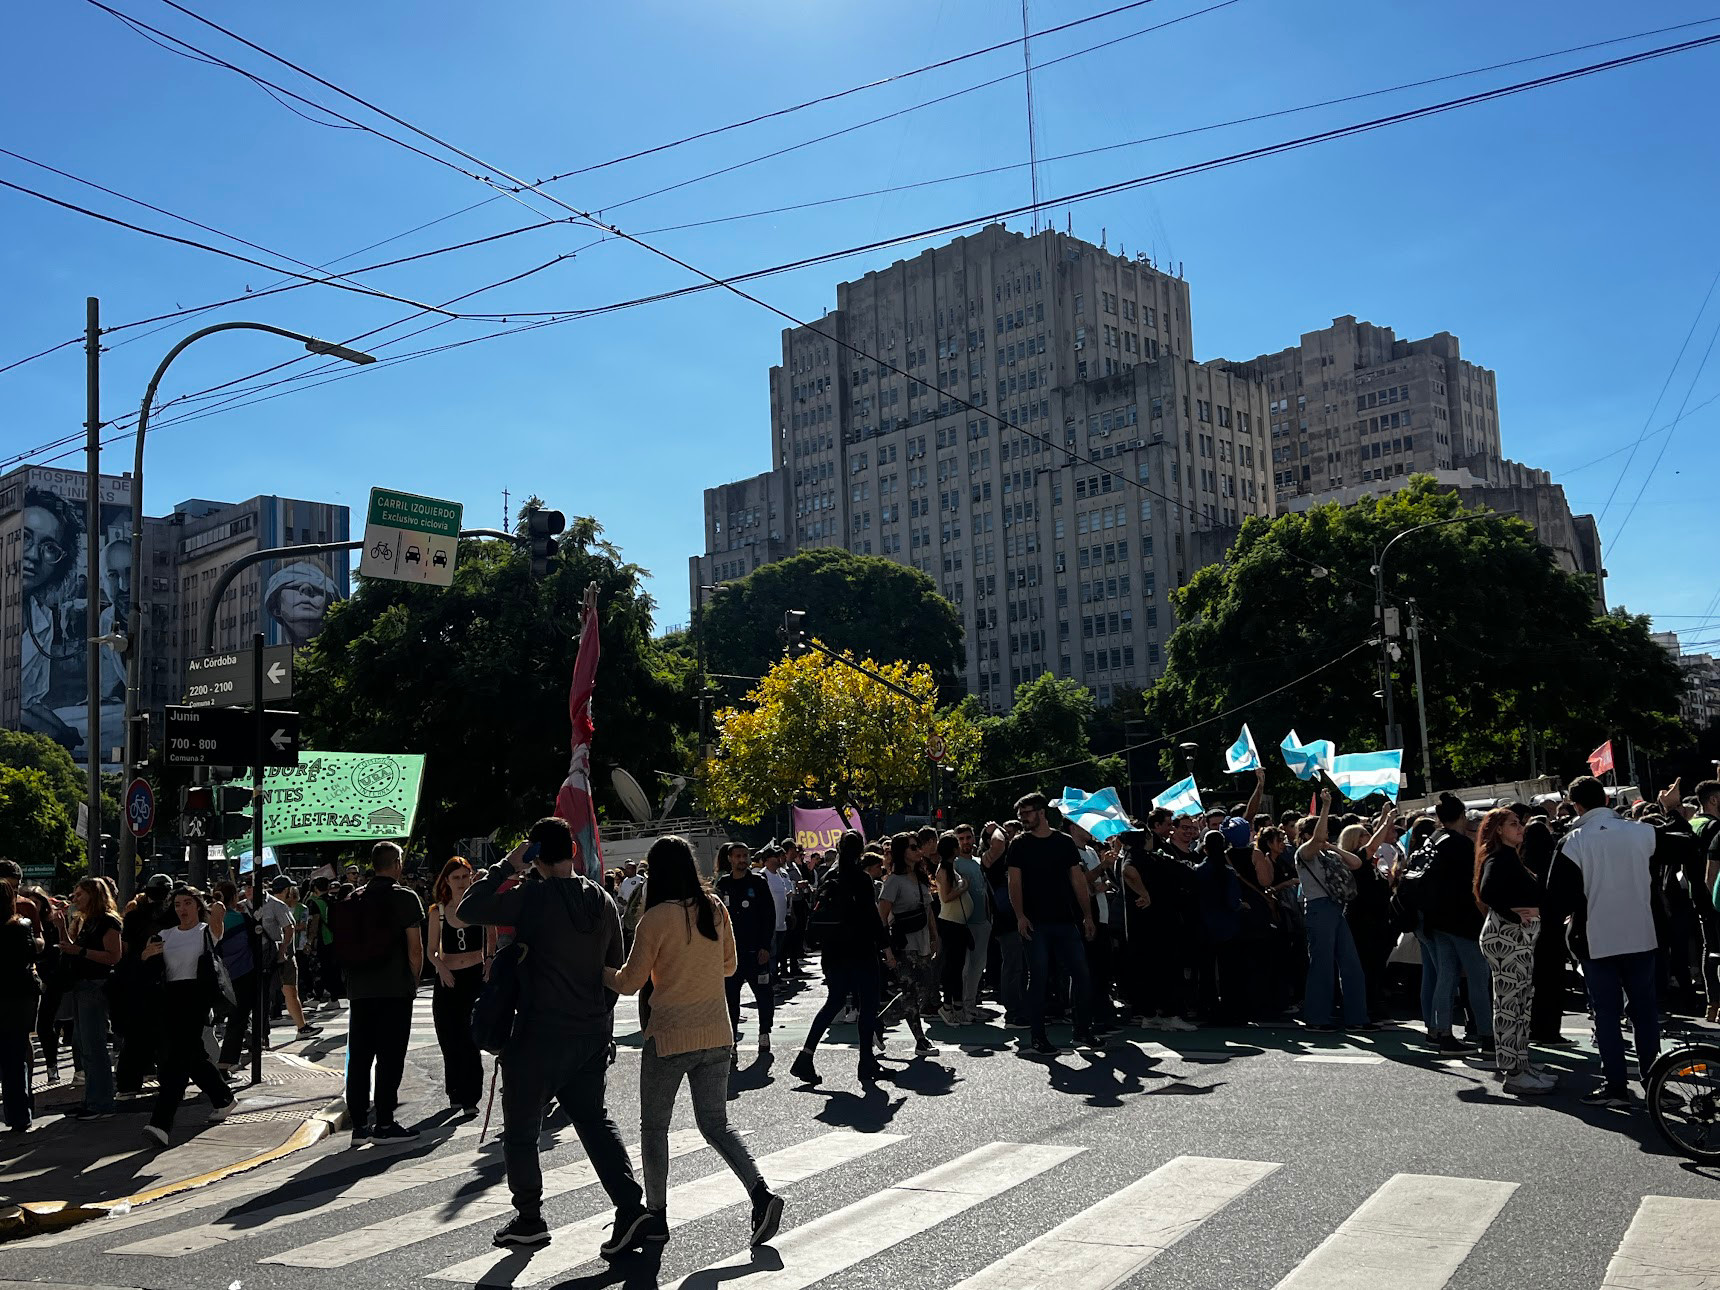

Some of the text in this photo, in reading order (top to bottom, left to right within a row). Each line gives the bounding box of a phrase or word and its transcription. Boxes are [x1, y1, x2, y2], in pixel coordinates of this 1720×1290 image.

[112, 480, 130, 492] DE
[377, 497, 456, 519] CARRIL IZQUIERDO
[382, 510, 419, 525] Exclusivo
[189, 655, 237, 671] Av. Córdoba
[189, 684, 208, 697] 2200
[214, 681, 233, 694] 2100
[189, 698, 215, 708] Comuna 2
[170, 738, 190, 749] 700
[198, 738, 217, 750] 800
[169, 753, 205, 762] Comuna 2
[261, 787, 304, 804] NTES
[268, 812, 362, 828] Y LETRAS
